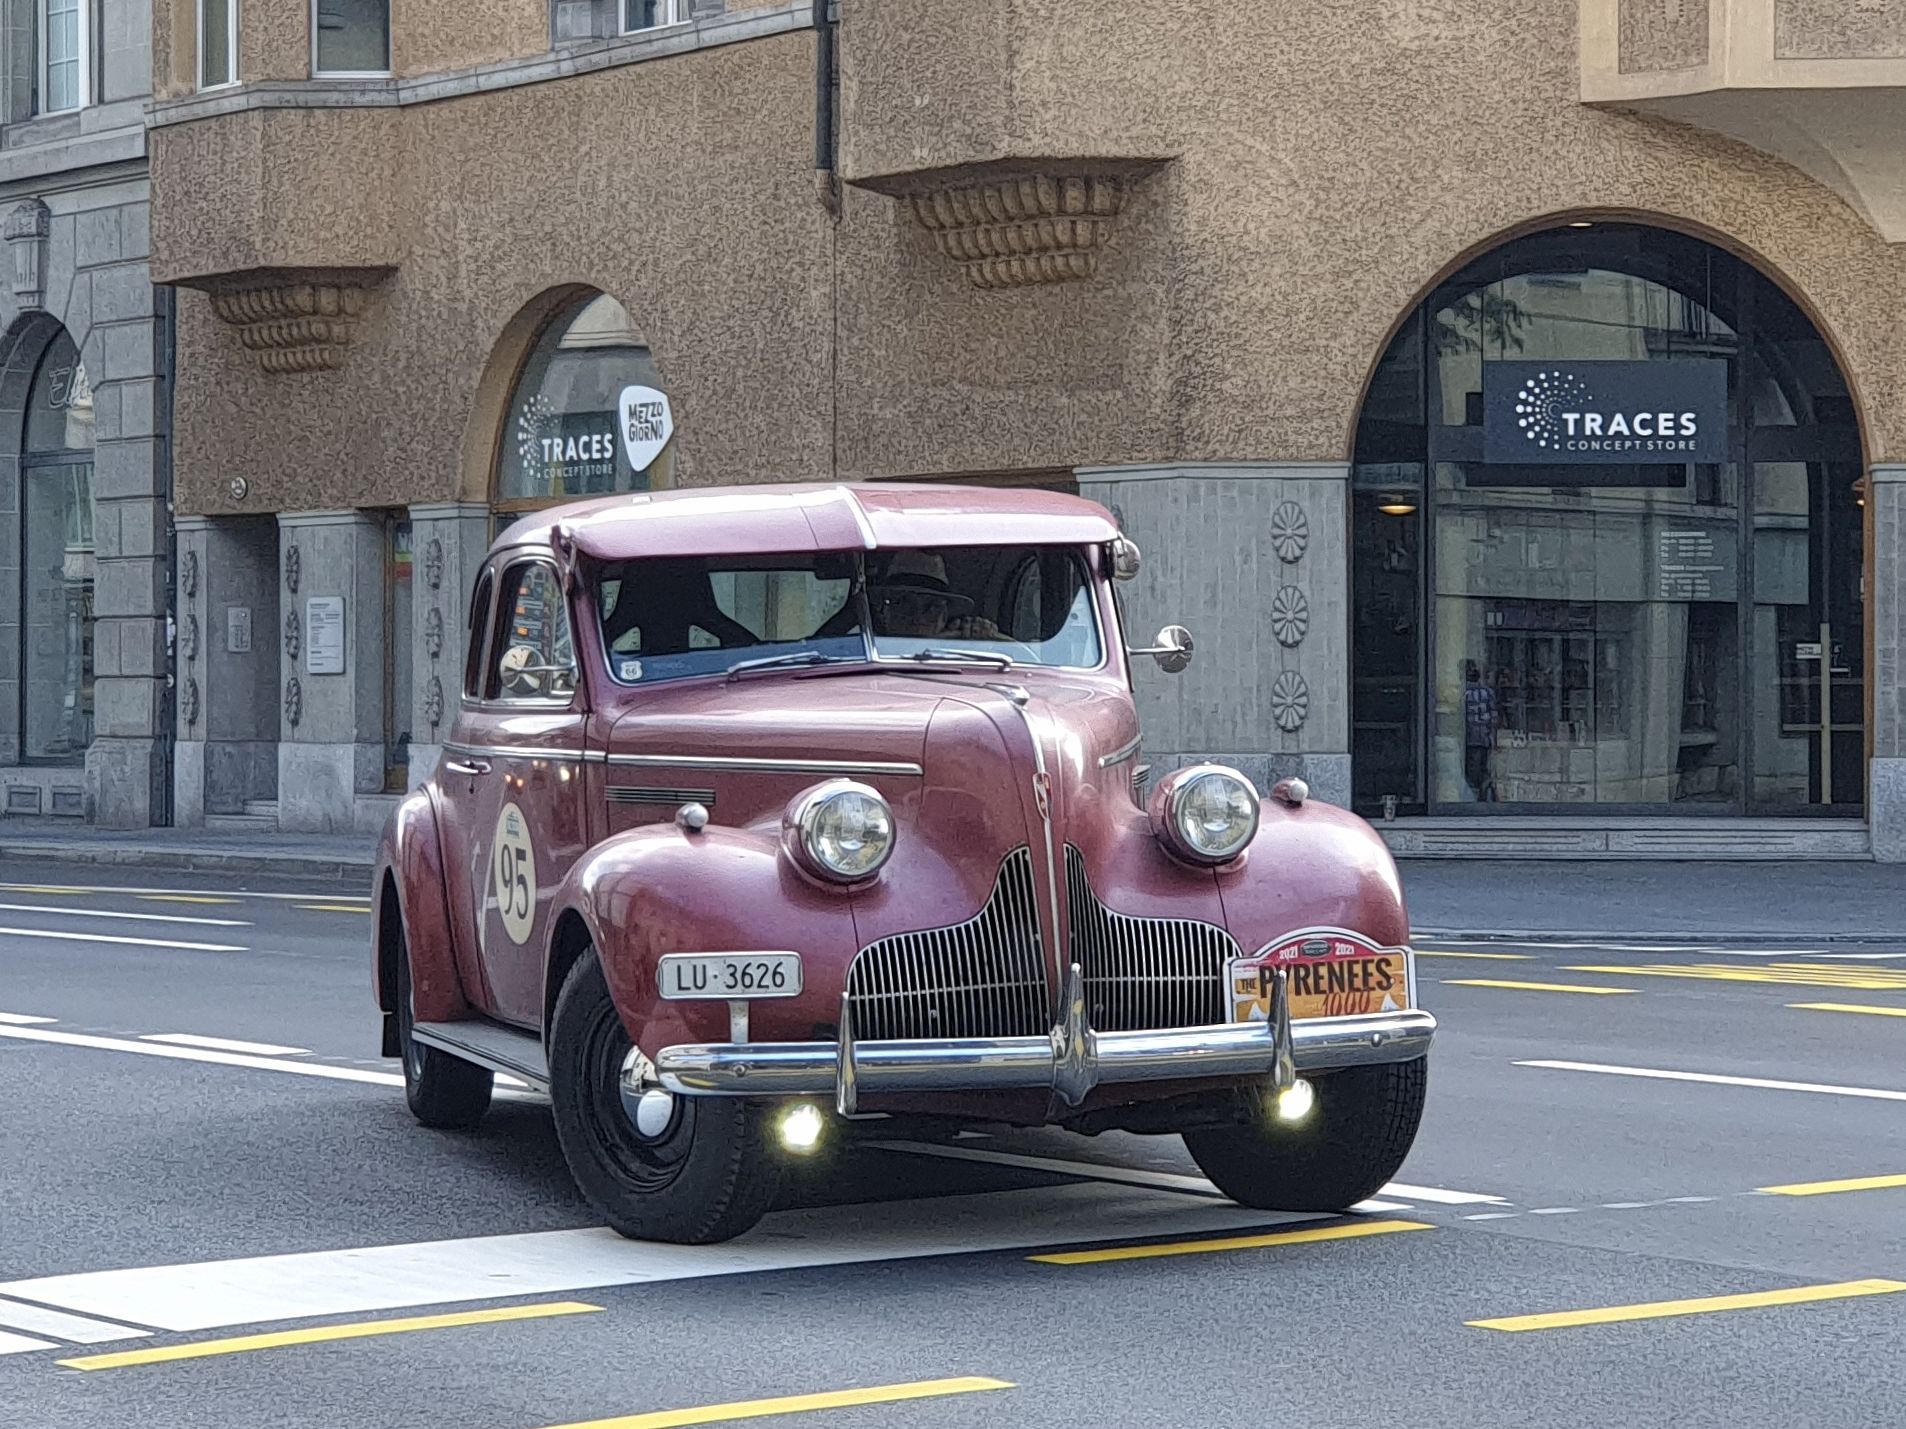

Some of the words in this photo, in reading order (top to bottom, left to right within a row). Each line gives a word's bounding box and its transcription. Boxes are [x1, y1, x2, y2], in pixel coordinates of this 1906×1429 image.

[628, 401, 664, 424] MEZZO
[1561, 412, 1697, 436] TRACES
[628, 420, 664, 442] GIORNO
[541, 433, 613, 462] TRACES
[1566, 440, 1642, 451] CONCEPT
[1646, 440, 1697, 451] STORE
[543, 465, 584, 479] CONCEPT
[585, 463, 613, 476] STORE
[501, 843, 529, 920] 95
[1279, 944, 1298, 960] 2021
[1334, 942, 1355, 956] 2021
[1321, 990, 1370, 1017] 1000
